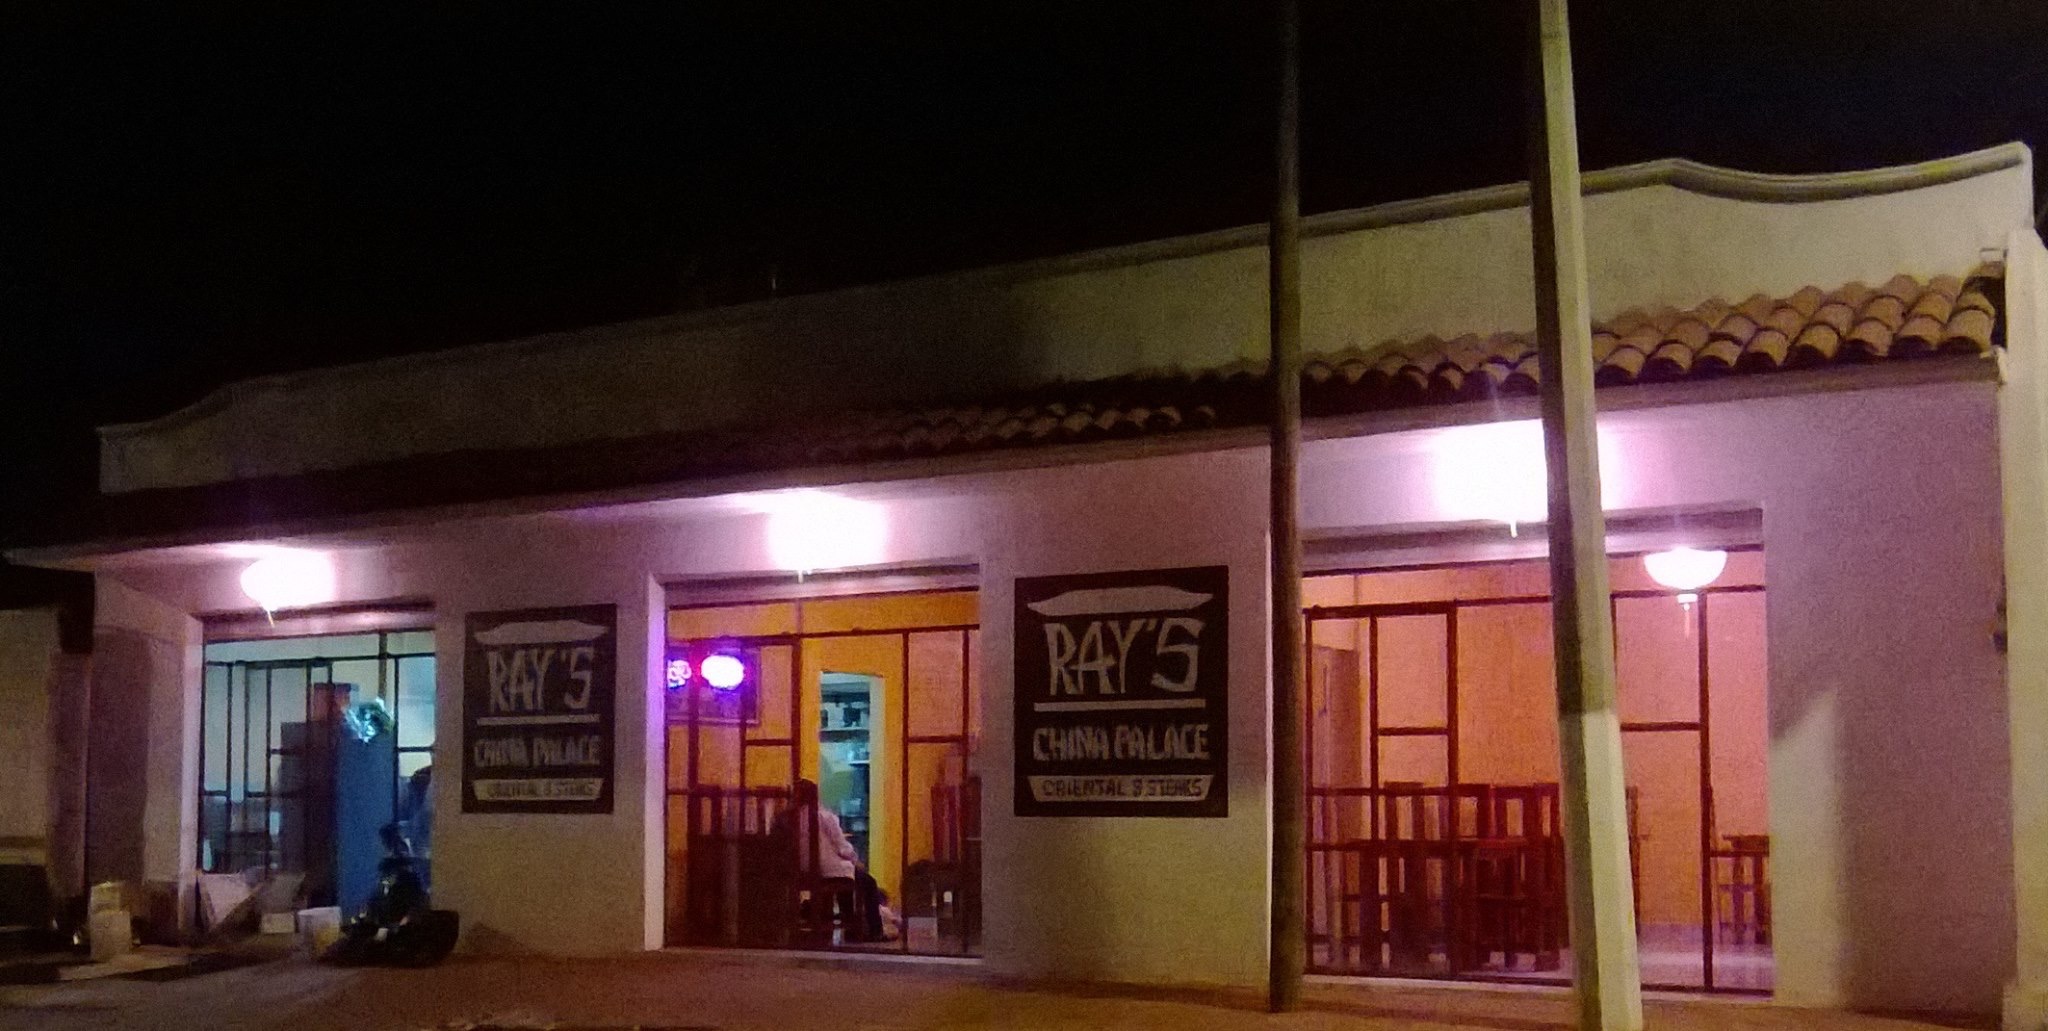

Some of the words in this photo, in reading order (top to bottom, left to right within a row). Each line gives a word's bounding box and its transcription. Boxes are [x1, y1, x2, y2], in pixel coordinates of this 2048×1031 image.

[487, 647, 594, 713] RAY'S
[1044, 617, 1206, 696] RAY'S
[1033, 726, 1109, 761] CHINA
[1114, 723, 1210, 761] PALACE
[1043, 778, 1124, 797] ORIENTAL
